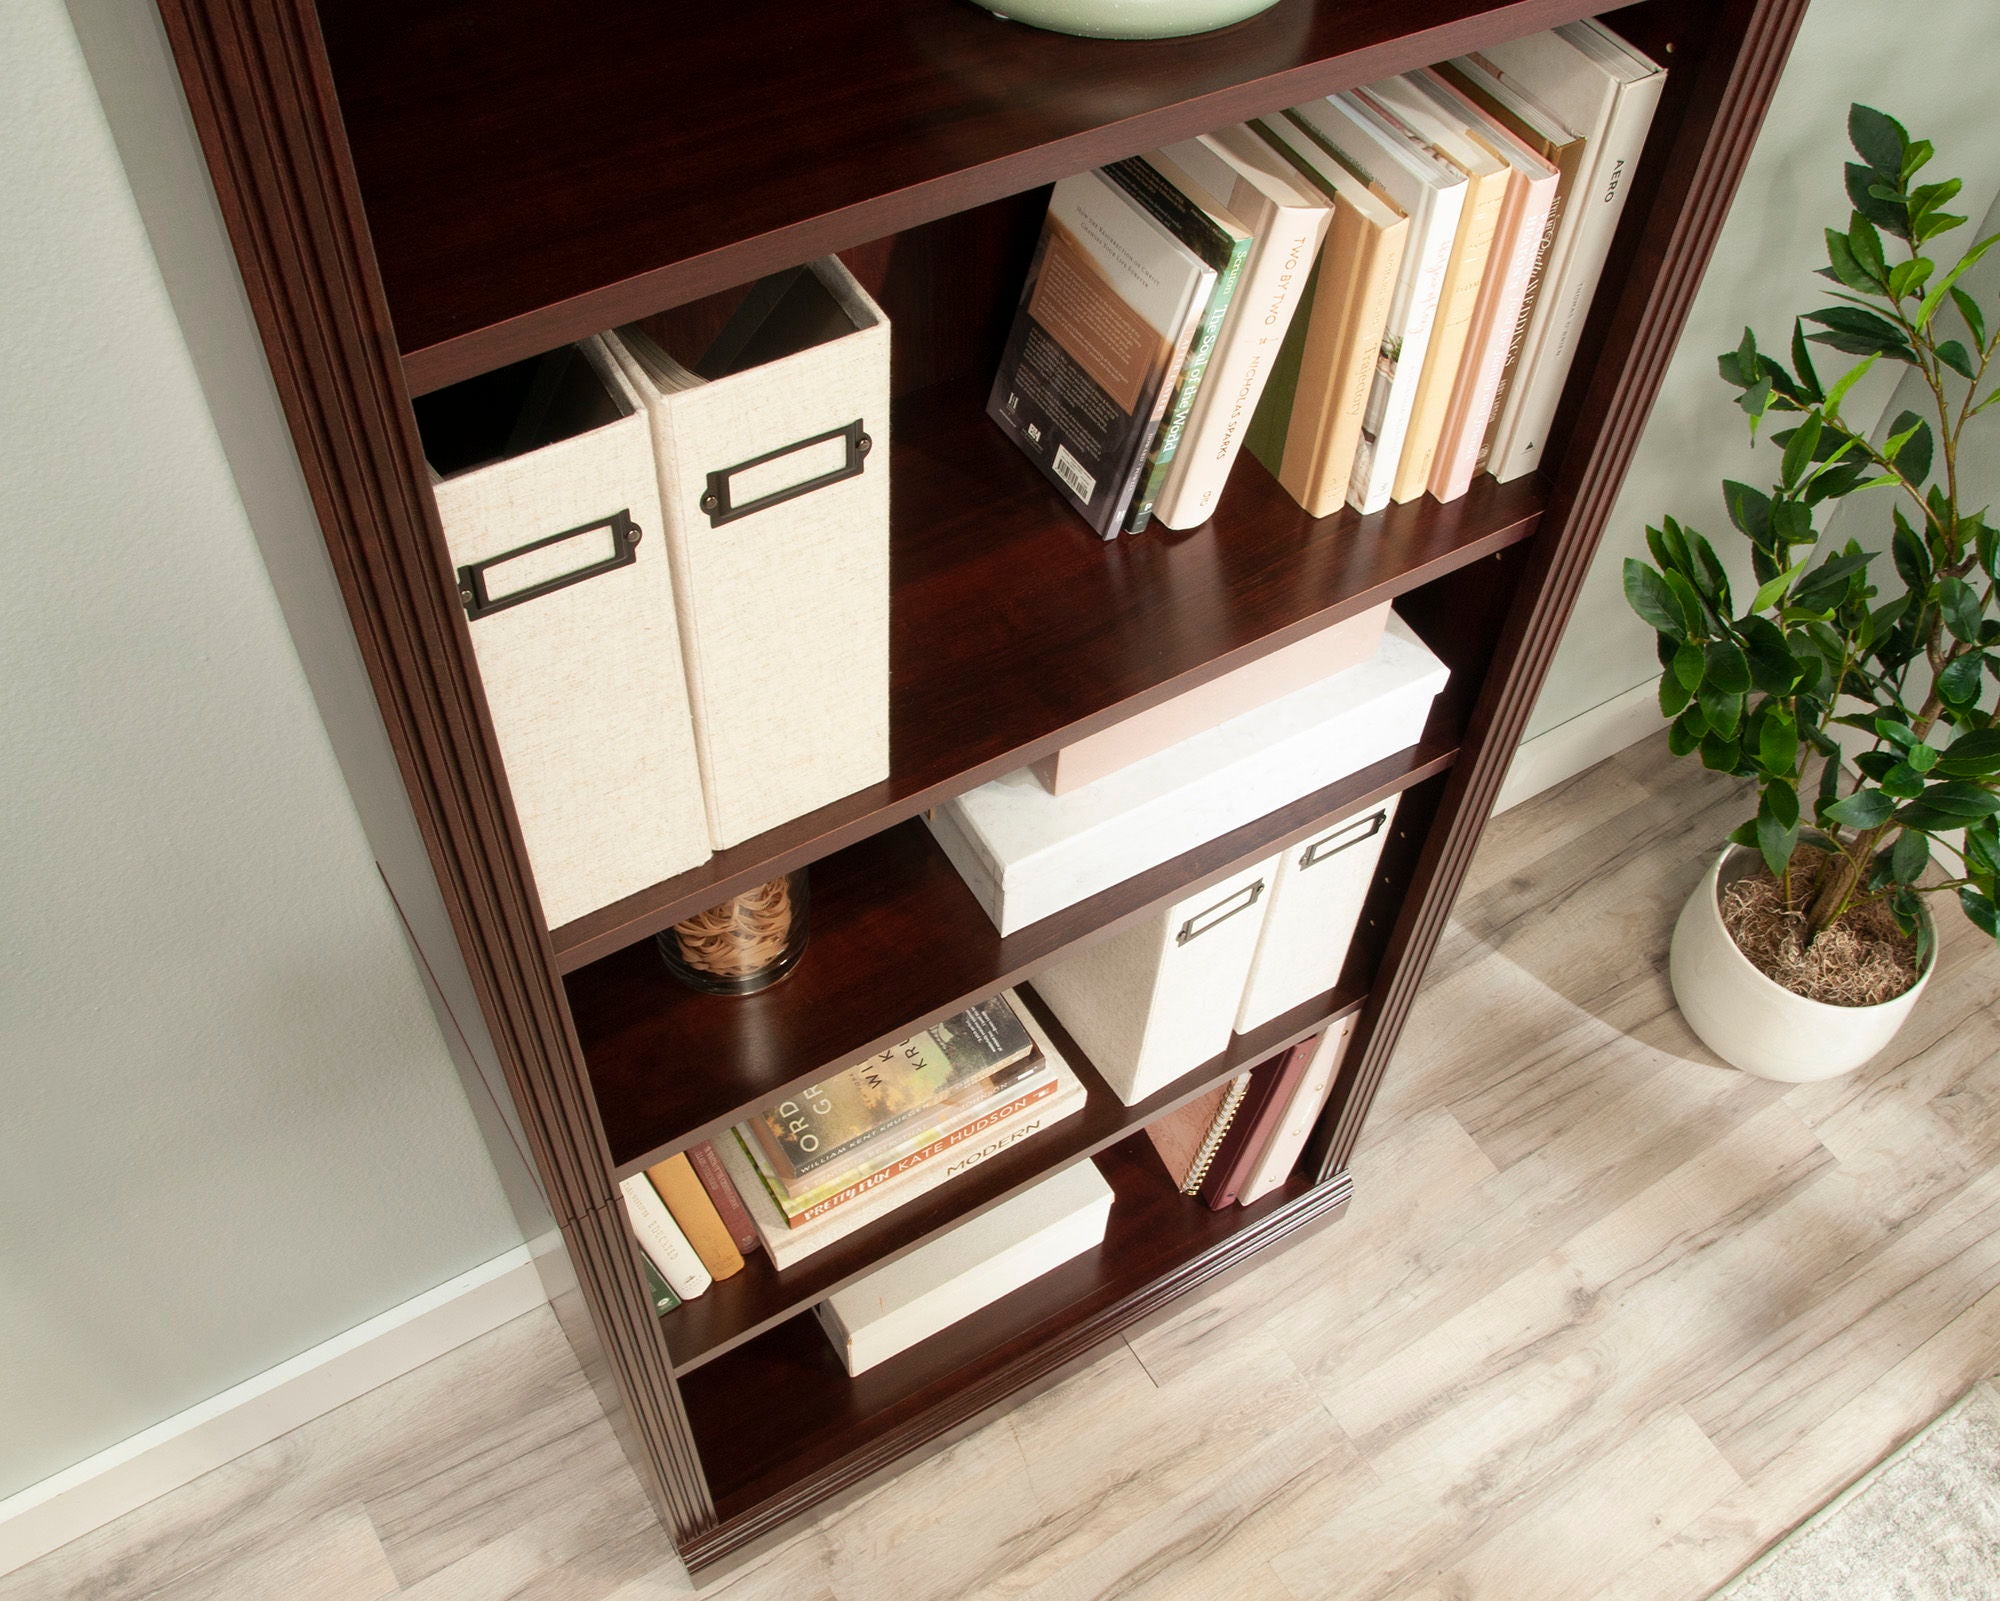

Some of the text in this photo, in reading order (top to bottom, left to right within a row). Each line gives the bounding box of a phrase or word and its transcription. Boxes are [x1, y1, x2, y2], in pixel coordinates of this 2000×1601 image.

[1602, 158, 1626, 203] AERO
[1140, 264, 1161, 286] CHRIST
[1161, 250, 1248, 453] Scruton The Soul of the World
[1213, 236, 1306, 462] TWO BY TWO NICHOLAS SPARKS
[1504, 278, 1539, 366] WEDDINGS
[1348, 342, 1377, 416] Trajectory
[960, 1082, 1009, 1111] JOHNSON
[800, 1103, 930, 1174] WILLIAM KENT KRUEGER
[804, 1098, 1028, 1221] PRETTY FUN KATE HUDSON
[946, 1119, 1041, 1177] MODERN
[646, 1219, 680, 1261] EDUCATED
